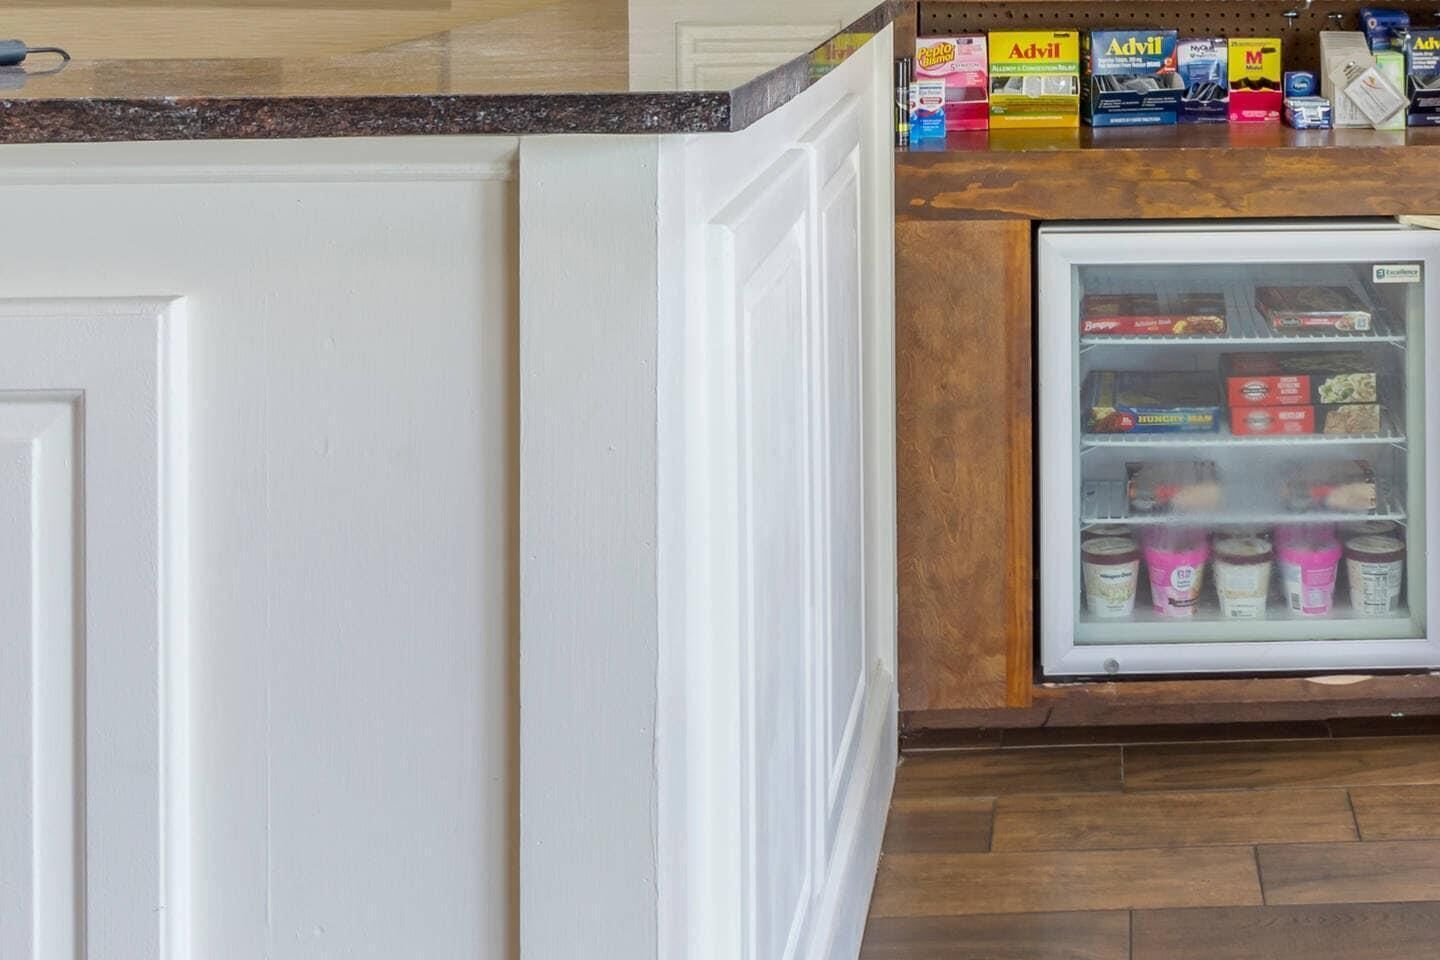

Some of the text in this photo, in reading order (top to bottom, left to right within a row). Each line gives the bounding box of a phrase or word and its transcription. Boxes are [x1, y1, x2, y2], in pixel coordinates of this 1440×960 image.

[1008, 42, 1060, 59] Advil
[1105, 36, 1164, 56] Advil
[1246, 50, 1262, 65] M
